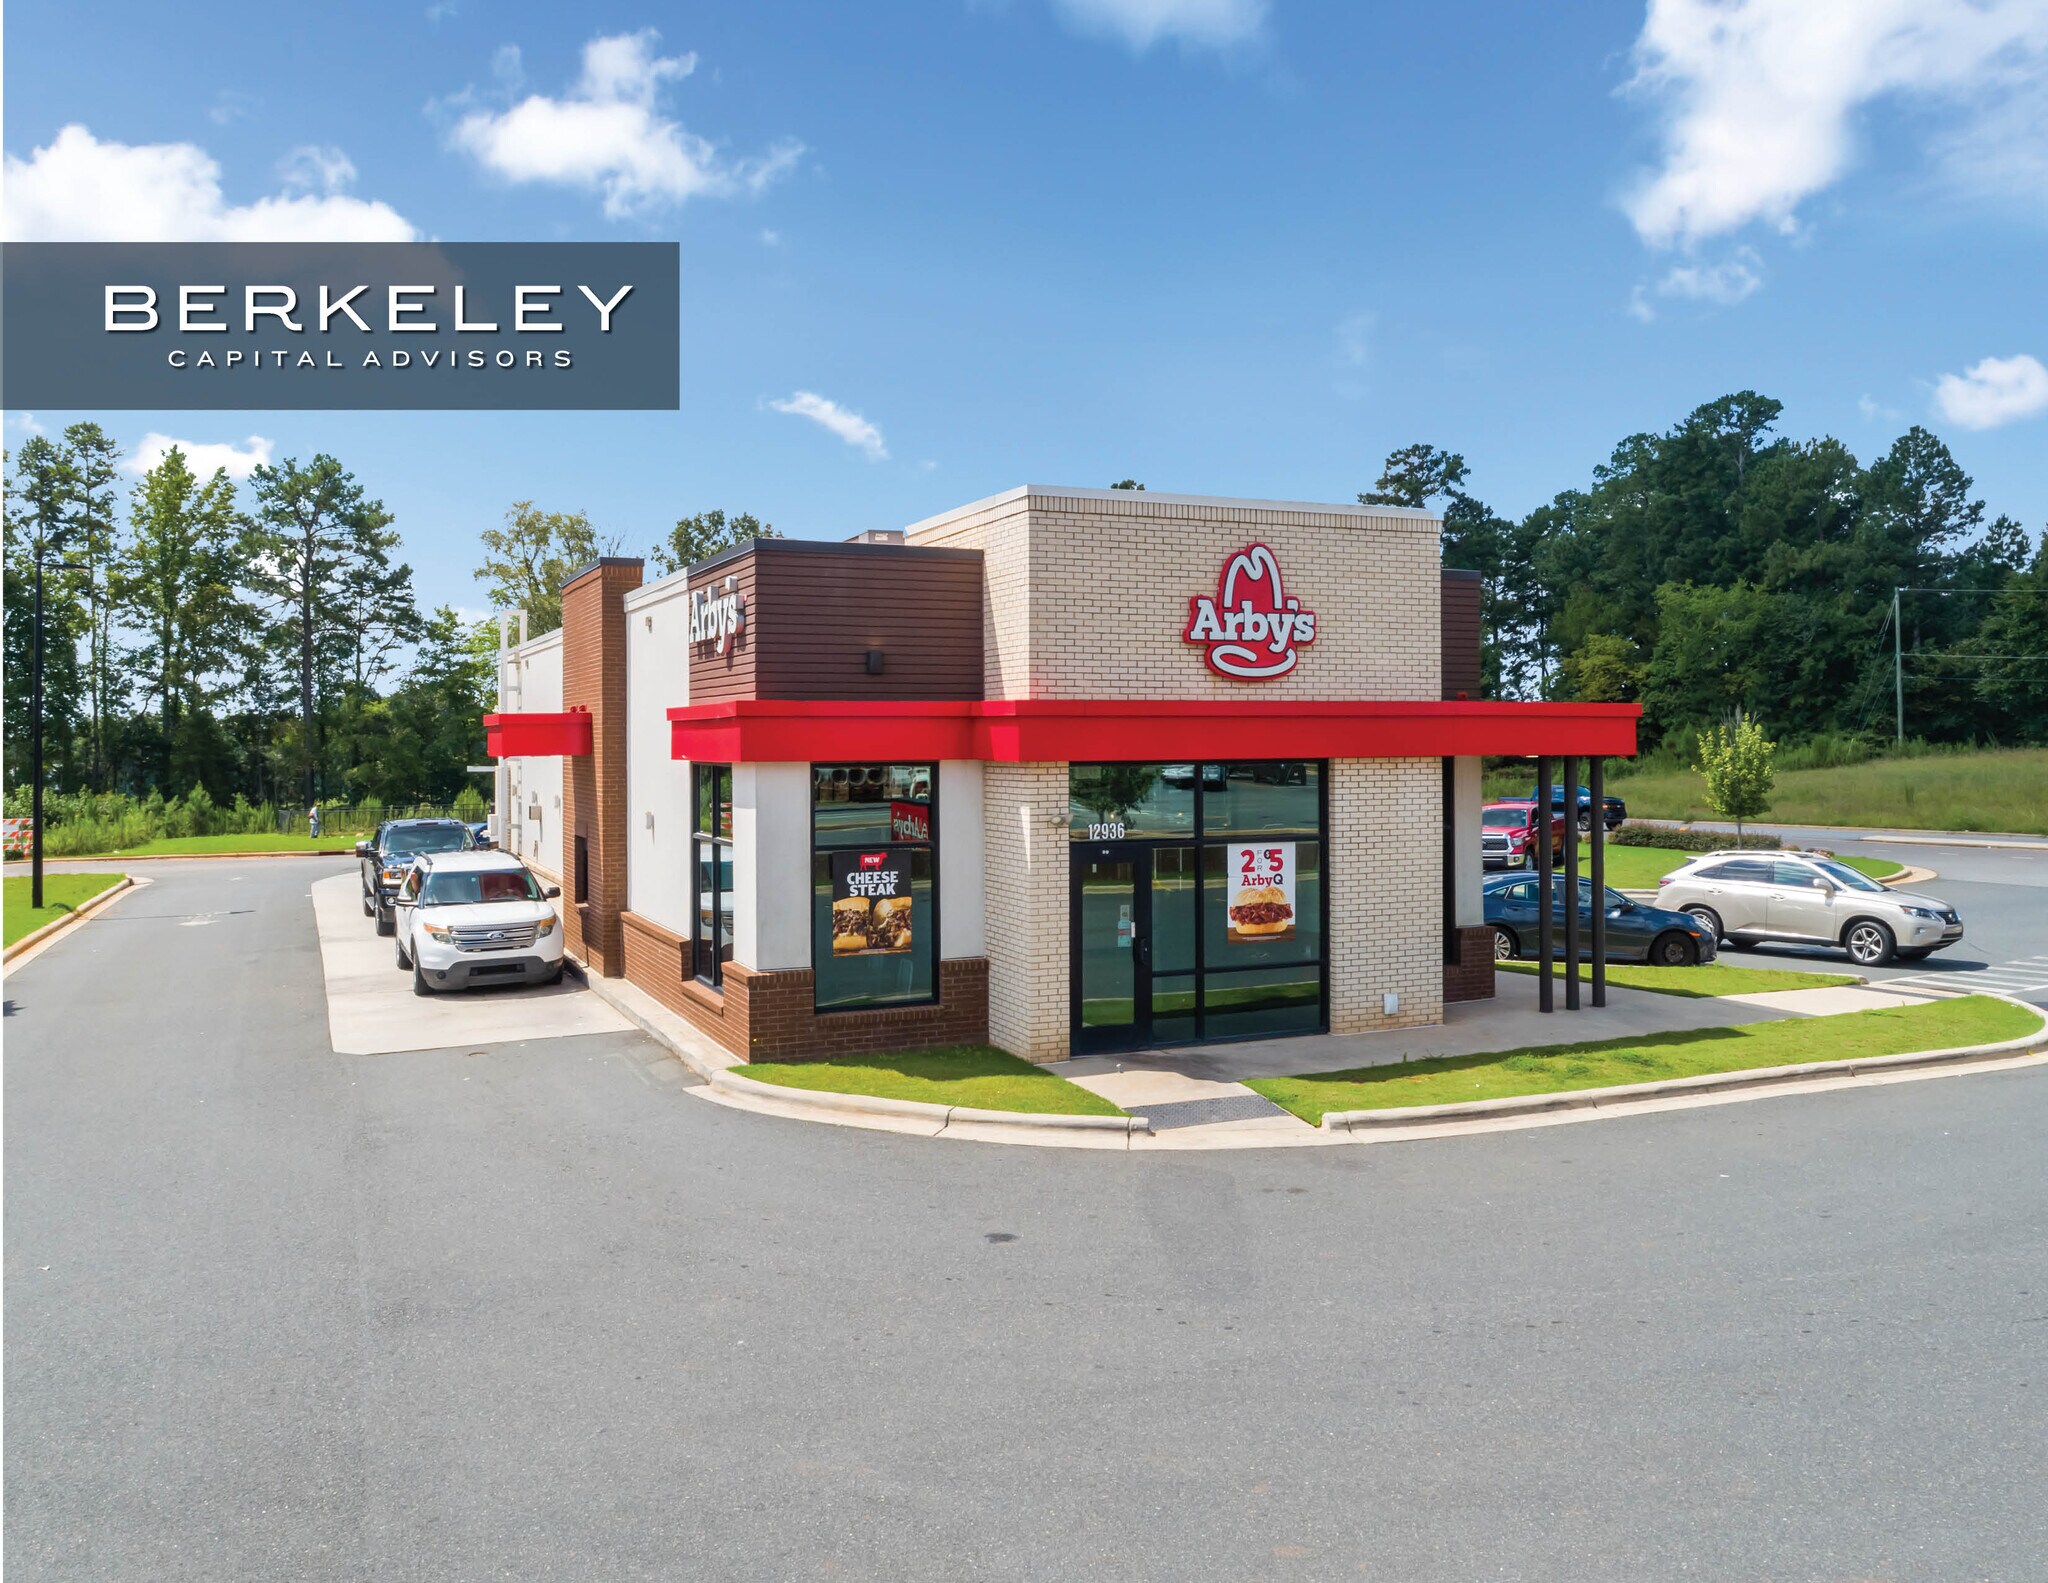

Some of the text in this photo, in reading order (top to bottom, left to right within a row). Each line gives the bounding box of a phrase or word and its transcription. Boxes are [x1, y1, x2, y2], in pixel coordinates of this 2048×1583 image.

[690, 576, 740, 654] Arby's
[1190, 599, 1315, 653] Arby's
[1088, 822, 1125, 840] 12936
[864, 856, 880, 864] NEW
[1240, 849, 1255, 872] 2
[846, 871, 899, 885] CHEESE
[1241, 873, 1284, 887] ArbyQ
[849, 883, 896, 897] STEAK
